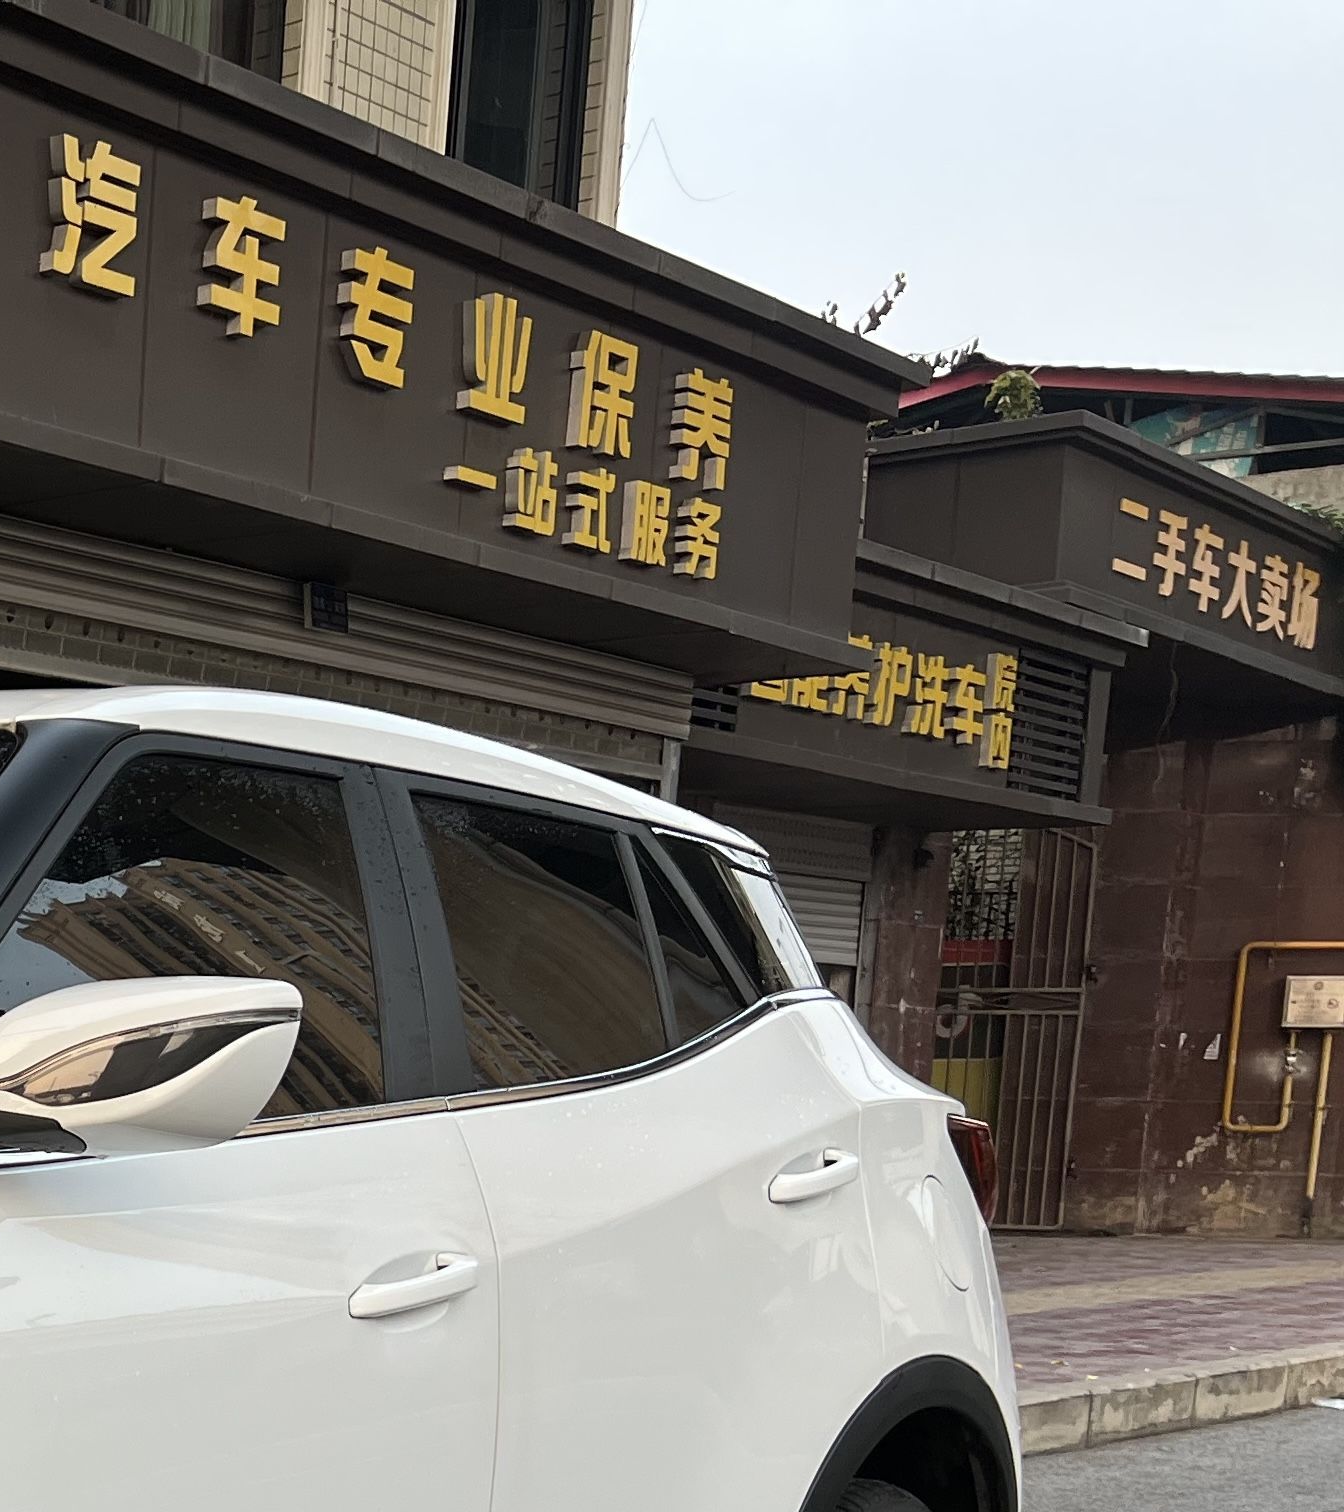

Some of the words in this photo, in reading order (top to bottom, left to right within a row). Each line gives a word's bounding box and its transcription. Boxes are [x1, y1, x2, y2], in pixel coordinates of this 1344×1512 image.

[39, 131, 735, 492] 汽车专业保养
[442, 447, 723, 580] 一站式服务
[1112, 496, 1324, 652] 二手车大卖场
